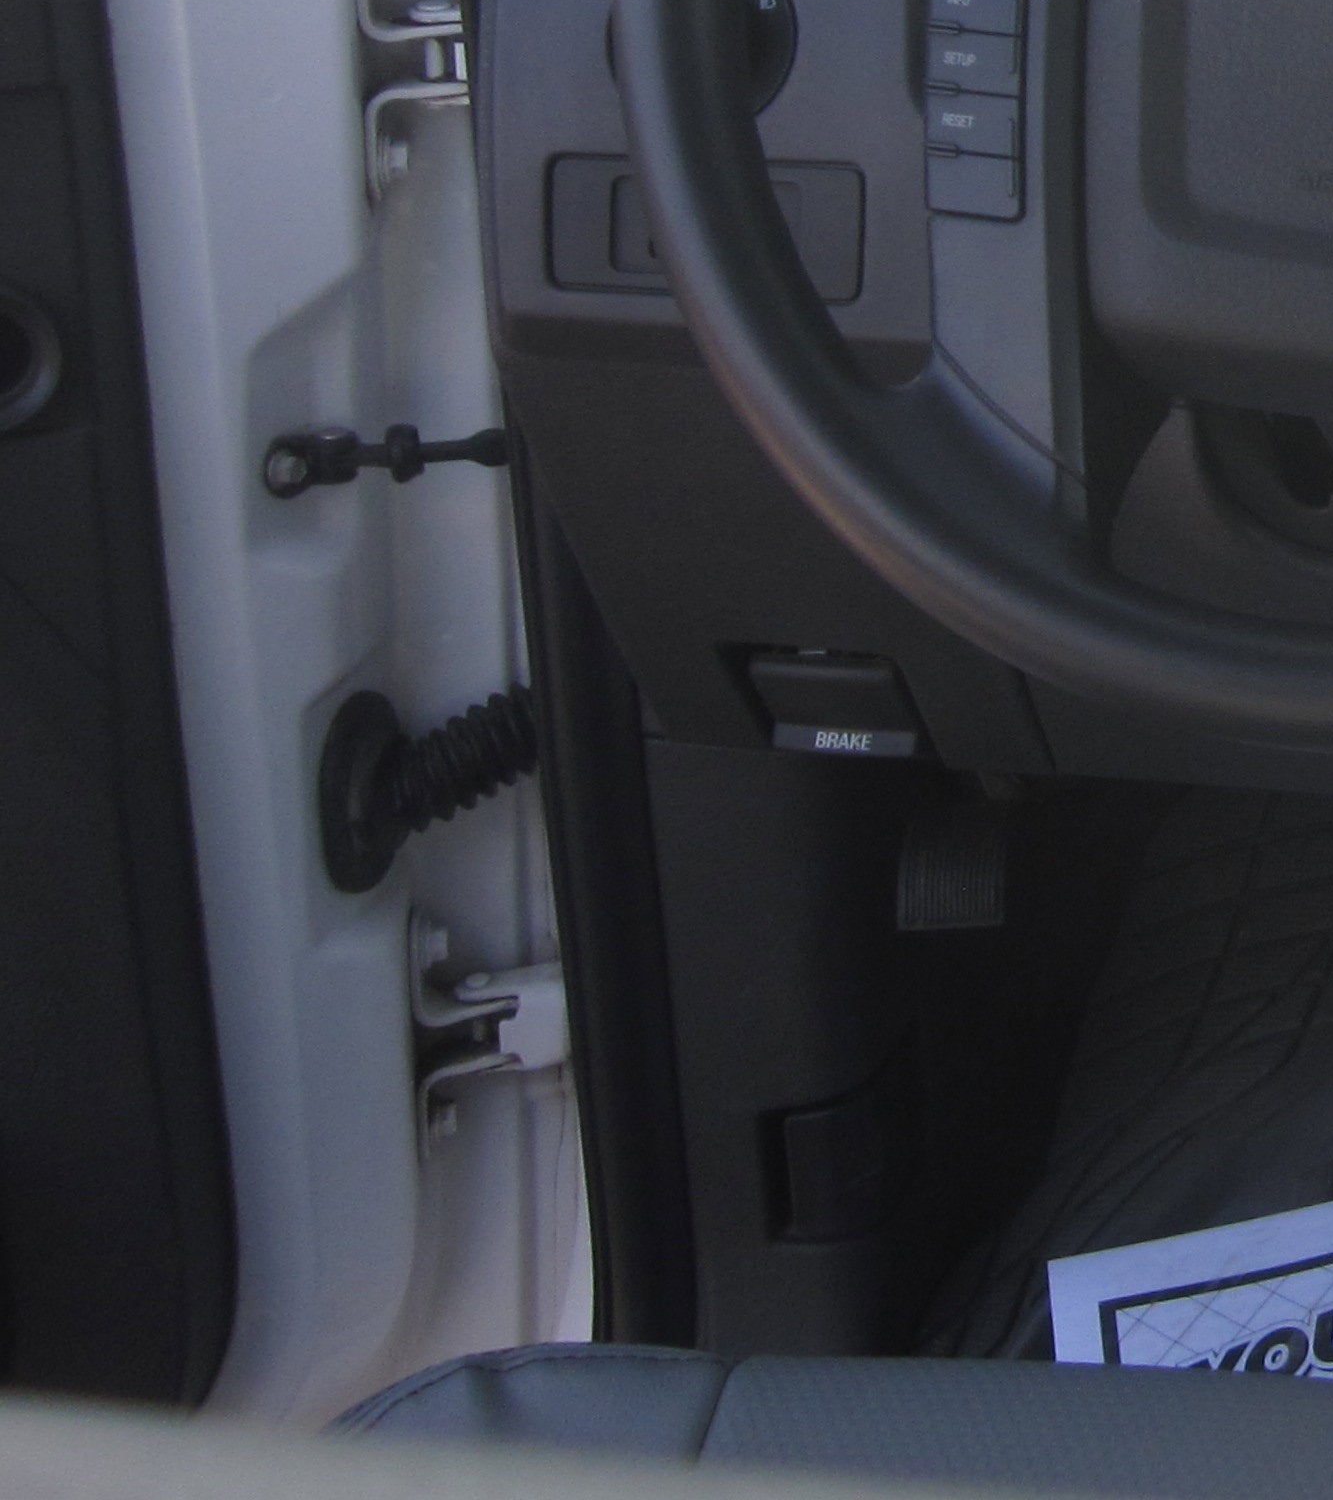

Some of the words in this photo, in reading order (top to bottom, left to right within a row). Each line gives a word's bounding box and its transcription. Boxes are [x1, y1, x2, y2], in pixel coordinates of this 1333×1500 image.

[942, 51, 977, 67] SETUP
[941, 112, 975, 128] RESET
[815, 731, 873, 750] BRAKE
